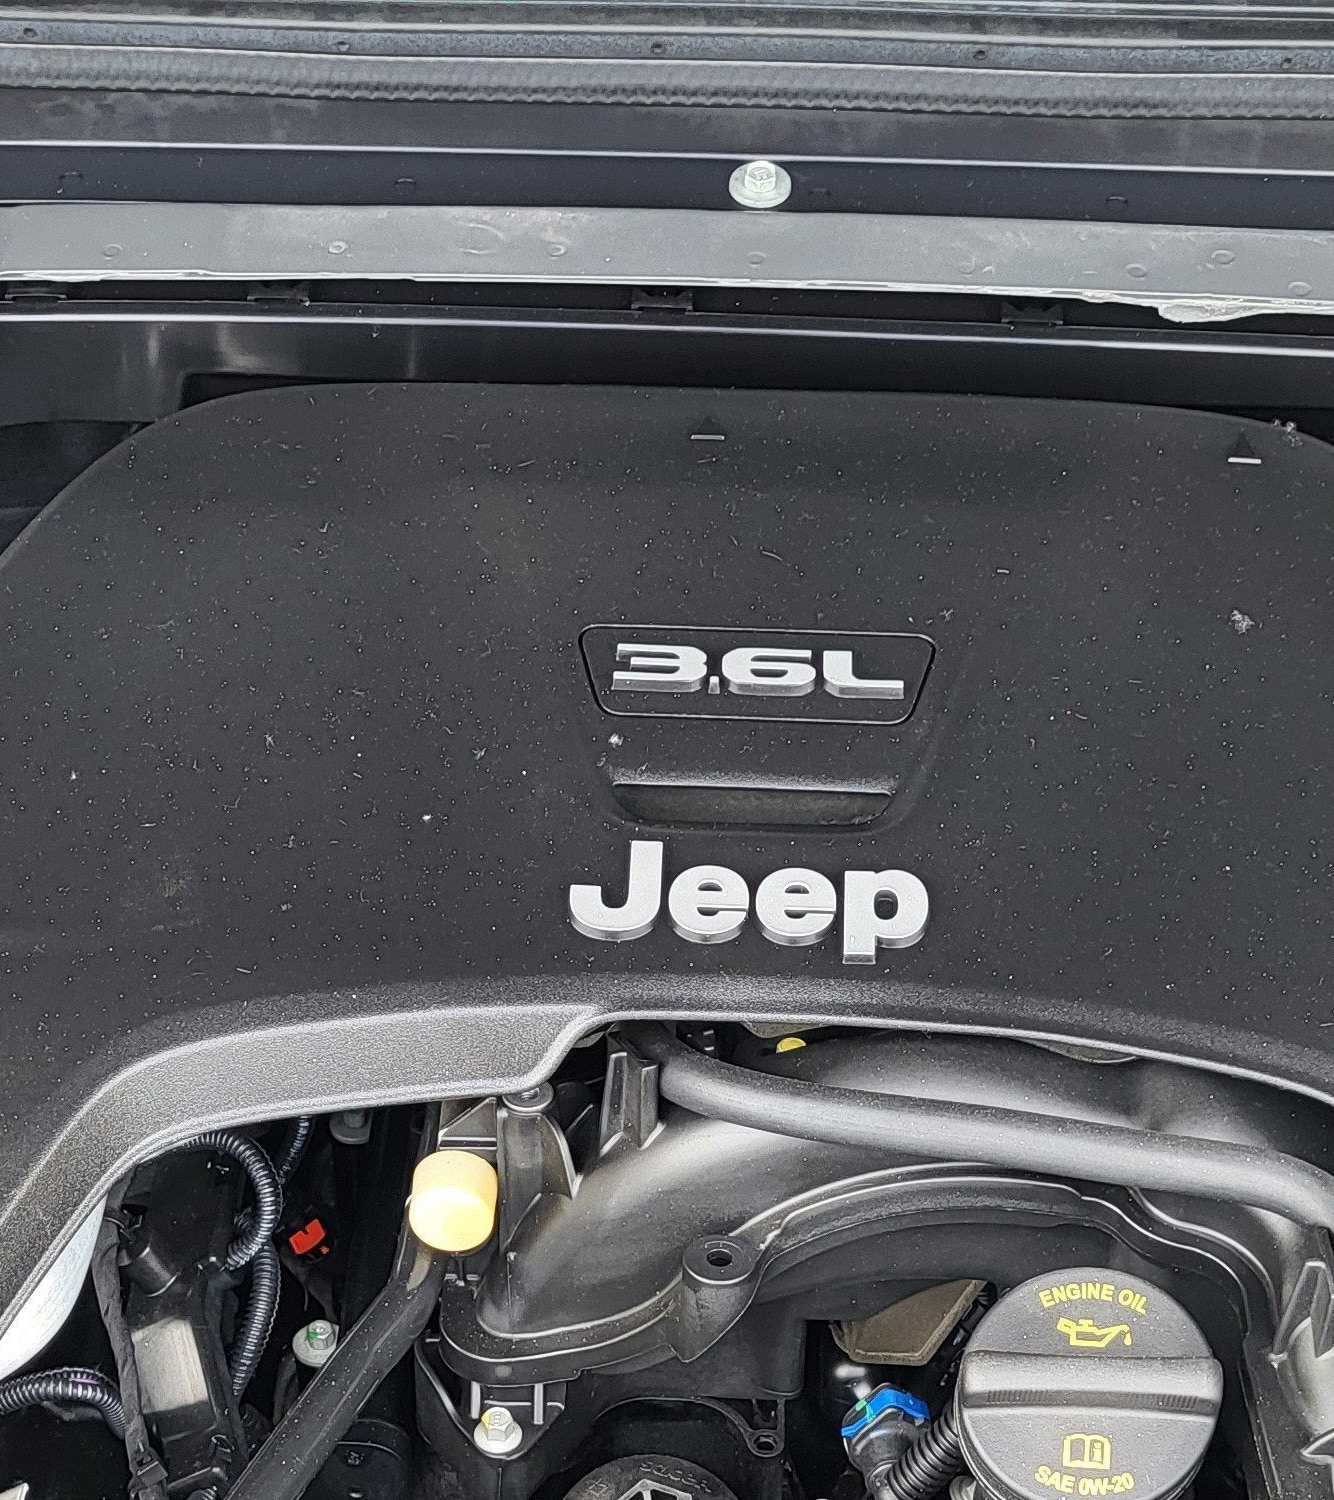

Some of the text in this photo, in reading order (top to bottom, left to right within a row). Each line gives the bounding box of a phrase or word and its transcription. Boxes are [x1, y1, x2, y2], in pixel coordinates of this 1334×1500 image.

[611, 642, 905, 700] 3.6L
[569, 840, 929, 965] Jeep
[1038, 1282, 1149, 1315] ENGINE OIL
[1034, 1465, 1135, 1496] SAE 0W-20
